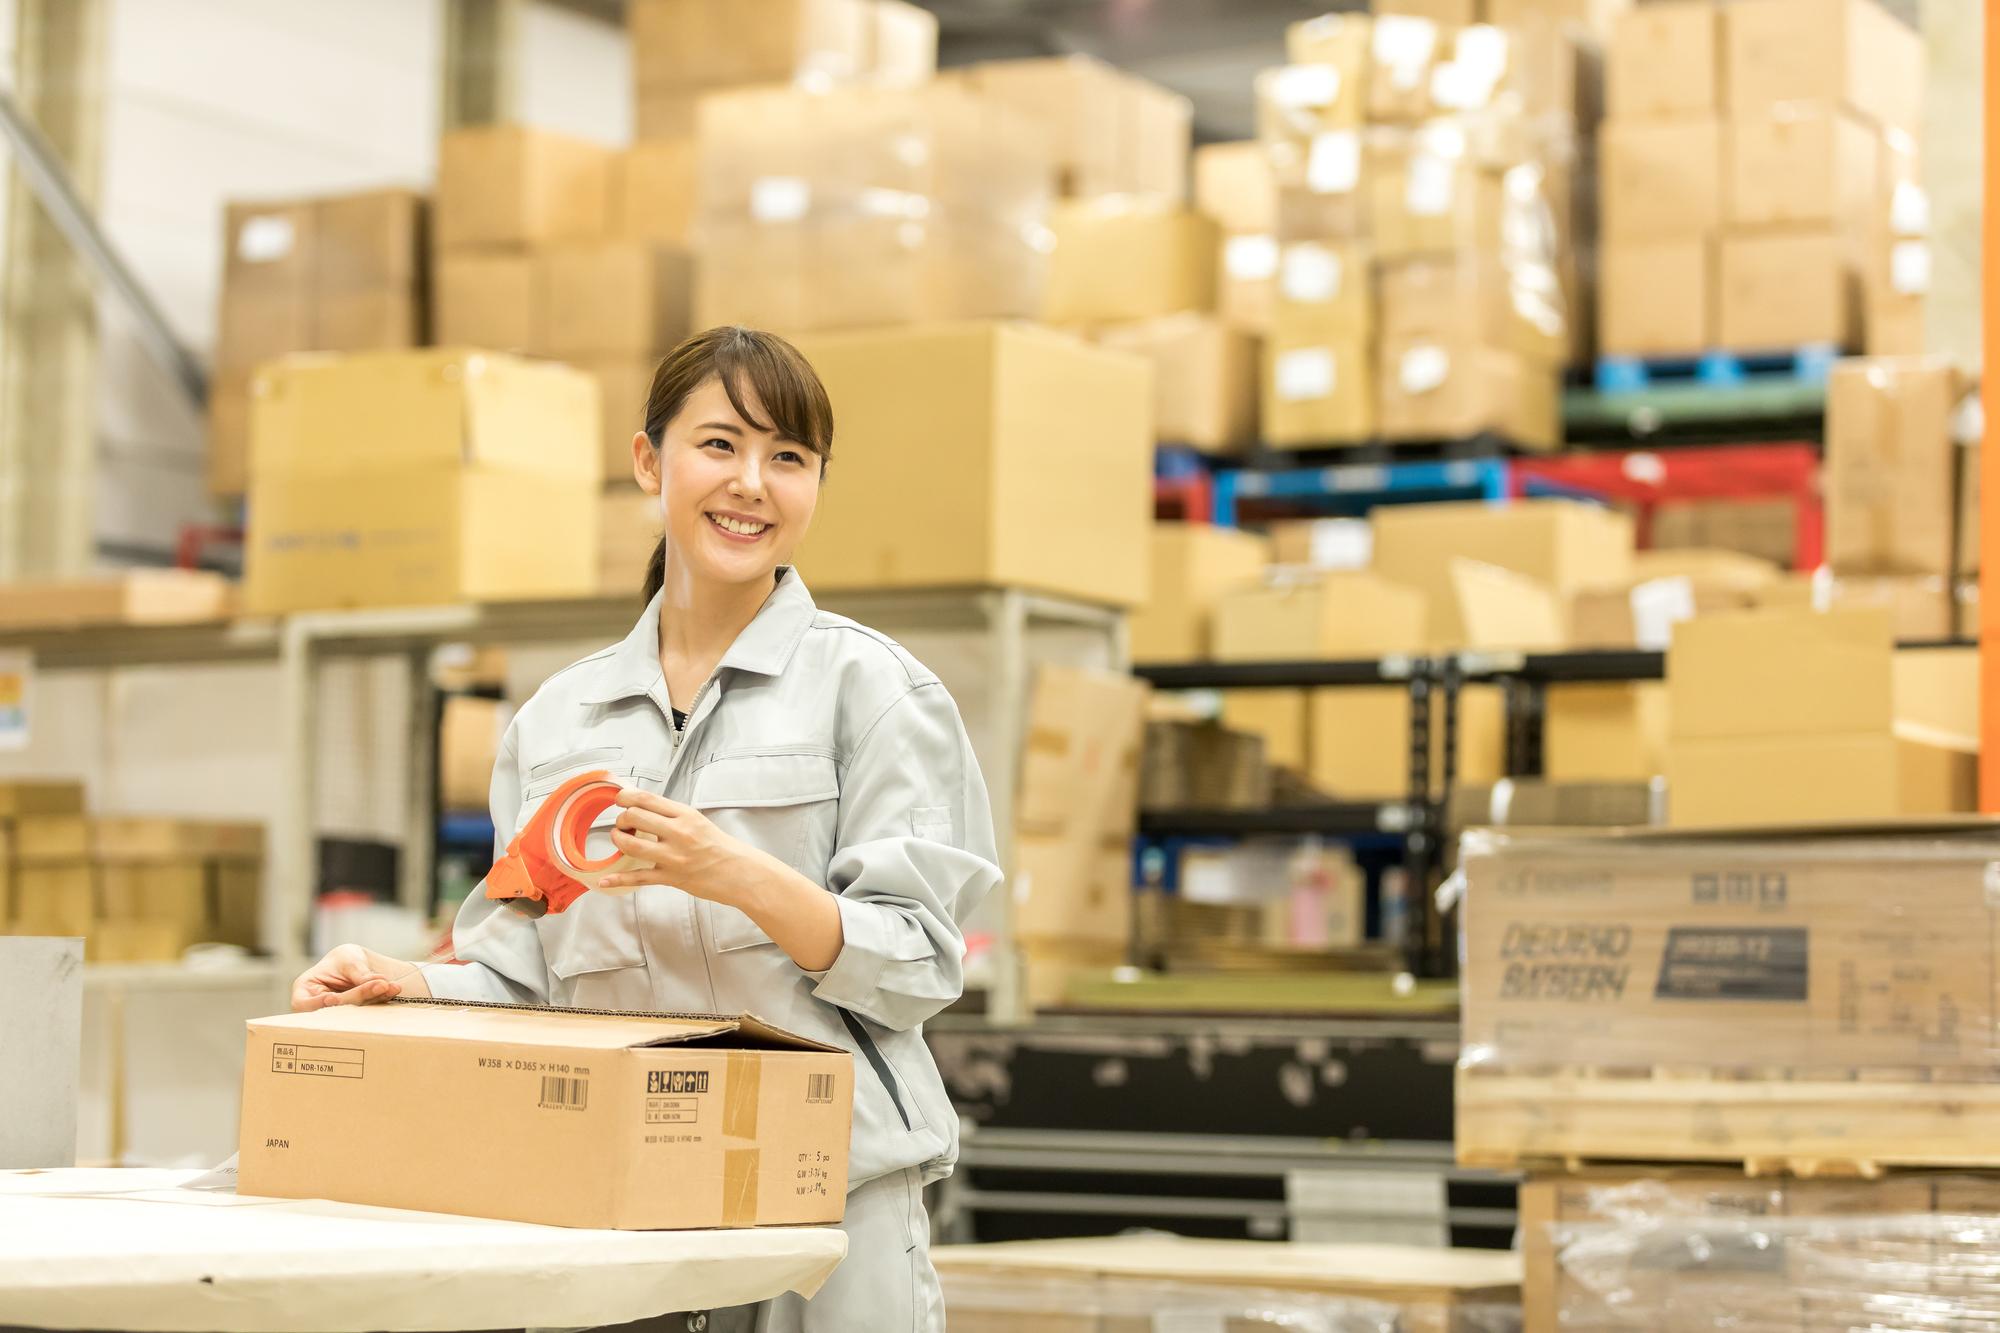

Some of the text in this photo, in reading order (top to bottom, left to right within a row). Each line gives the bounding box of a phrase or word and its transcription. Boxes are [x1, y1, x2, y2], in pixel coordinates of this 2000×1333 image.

[300, 1063, 334, 1073] NDR-167M
[478, 1057, 502, 1068] W358
[515, 1060, 537, 1071] D365
[548, 1063, 570, 1074] H140
[574, 1067, 590, 1075] mm
[266, 1138, 289, 1149] JAPAN
[816, 1151, 821, 1162] 5
